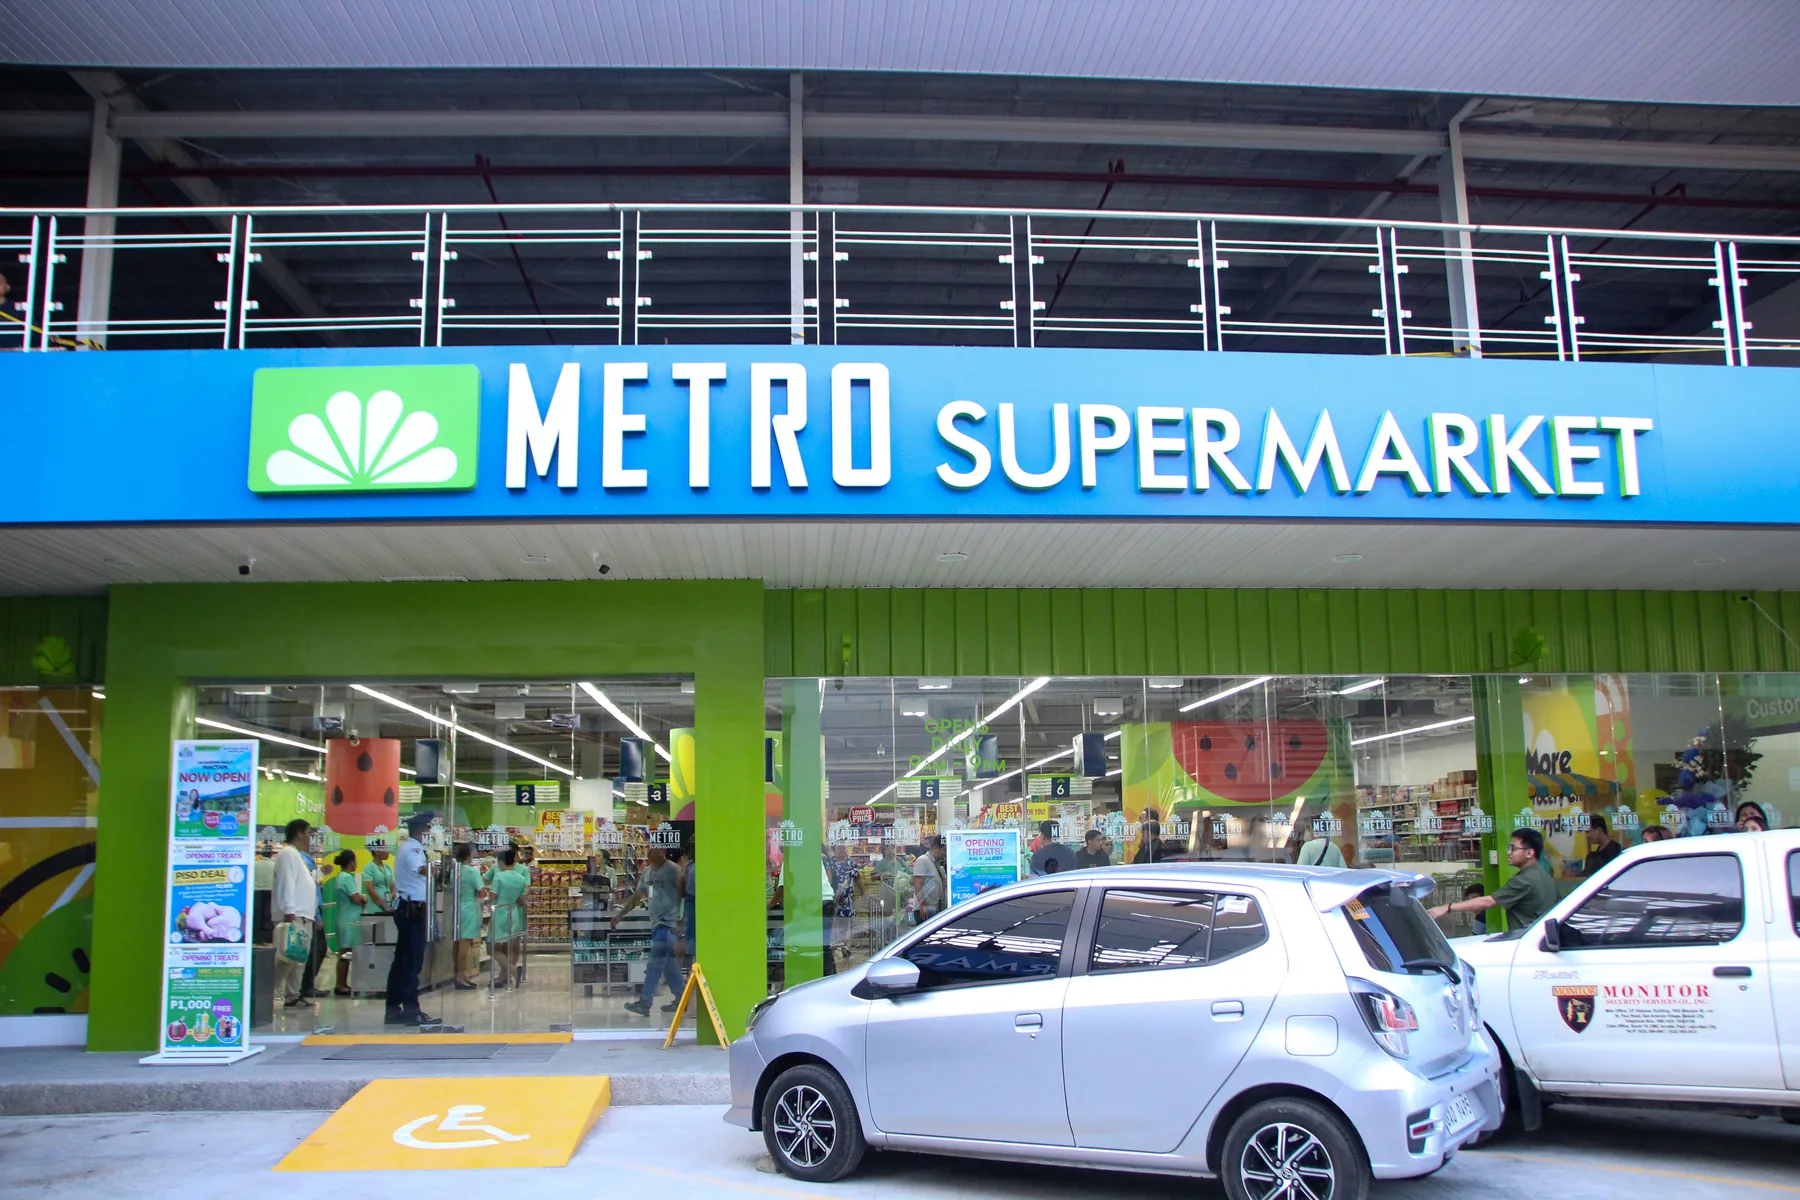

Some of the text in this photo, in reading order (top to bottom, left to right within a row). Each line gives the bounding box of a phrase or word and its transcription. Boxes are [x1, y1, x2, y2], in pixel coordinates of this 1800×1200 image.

[506, 362, 1654, 500] METRO SUPERMARKET
[932, 736, 983, 754] DAILY
[970, 755, 1006, 772] 9PM
[1526, 748, 1572, 774] More
[180, 772, 250, 782] NOW OPEN!
[926, 786, 934, 797] 5
[1056, 784, 1064, 795] 6
[521, 792, 529, 803] 2
[1000, 804, 1018, 813] BEST
[852, 815, 872, 823] PRICE
[998, 812, 1020, 821] DEALS
[1514, 816, 1541, 827] METRO
[1563, 816, 1590, 826] METRO
[1612, 814, 1638, 824] METRO
[1660, 813, 1686, 823] METRO
[1708, 812, 1733, 822] METRO
[1213, 823, 1242, 833] METRO
[1313, 821, 1342, 831] METRO
[1364, 819, 1391, 830] METRO
[1414, 818, 1442, 829] METRO
[1464, 817, 1492, 828] METRO
[828, 829, 859, 840] METRO
[1106, 825, 1135, 835] METRO
[1160, 824, 1189, 834] METRO
[478, 834, 509, 844] METRO
[594, 833, 623, 844] METRO
[650, 832, 680, 843] METRO
[772, 830, 803, 841] METRO
[176, 870, 226, 879] PISO DEAL
[1554, 986, 1596, 996] MONITOR
[1602, 984, 1710, 998] MONITOR
[170, 1000, 211, 1011] P1,000
